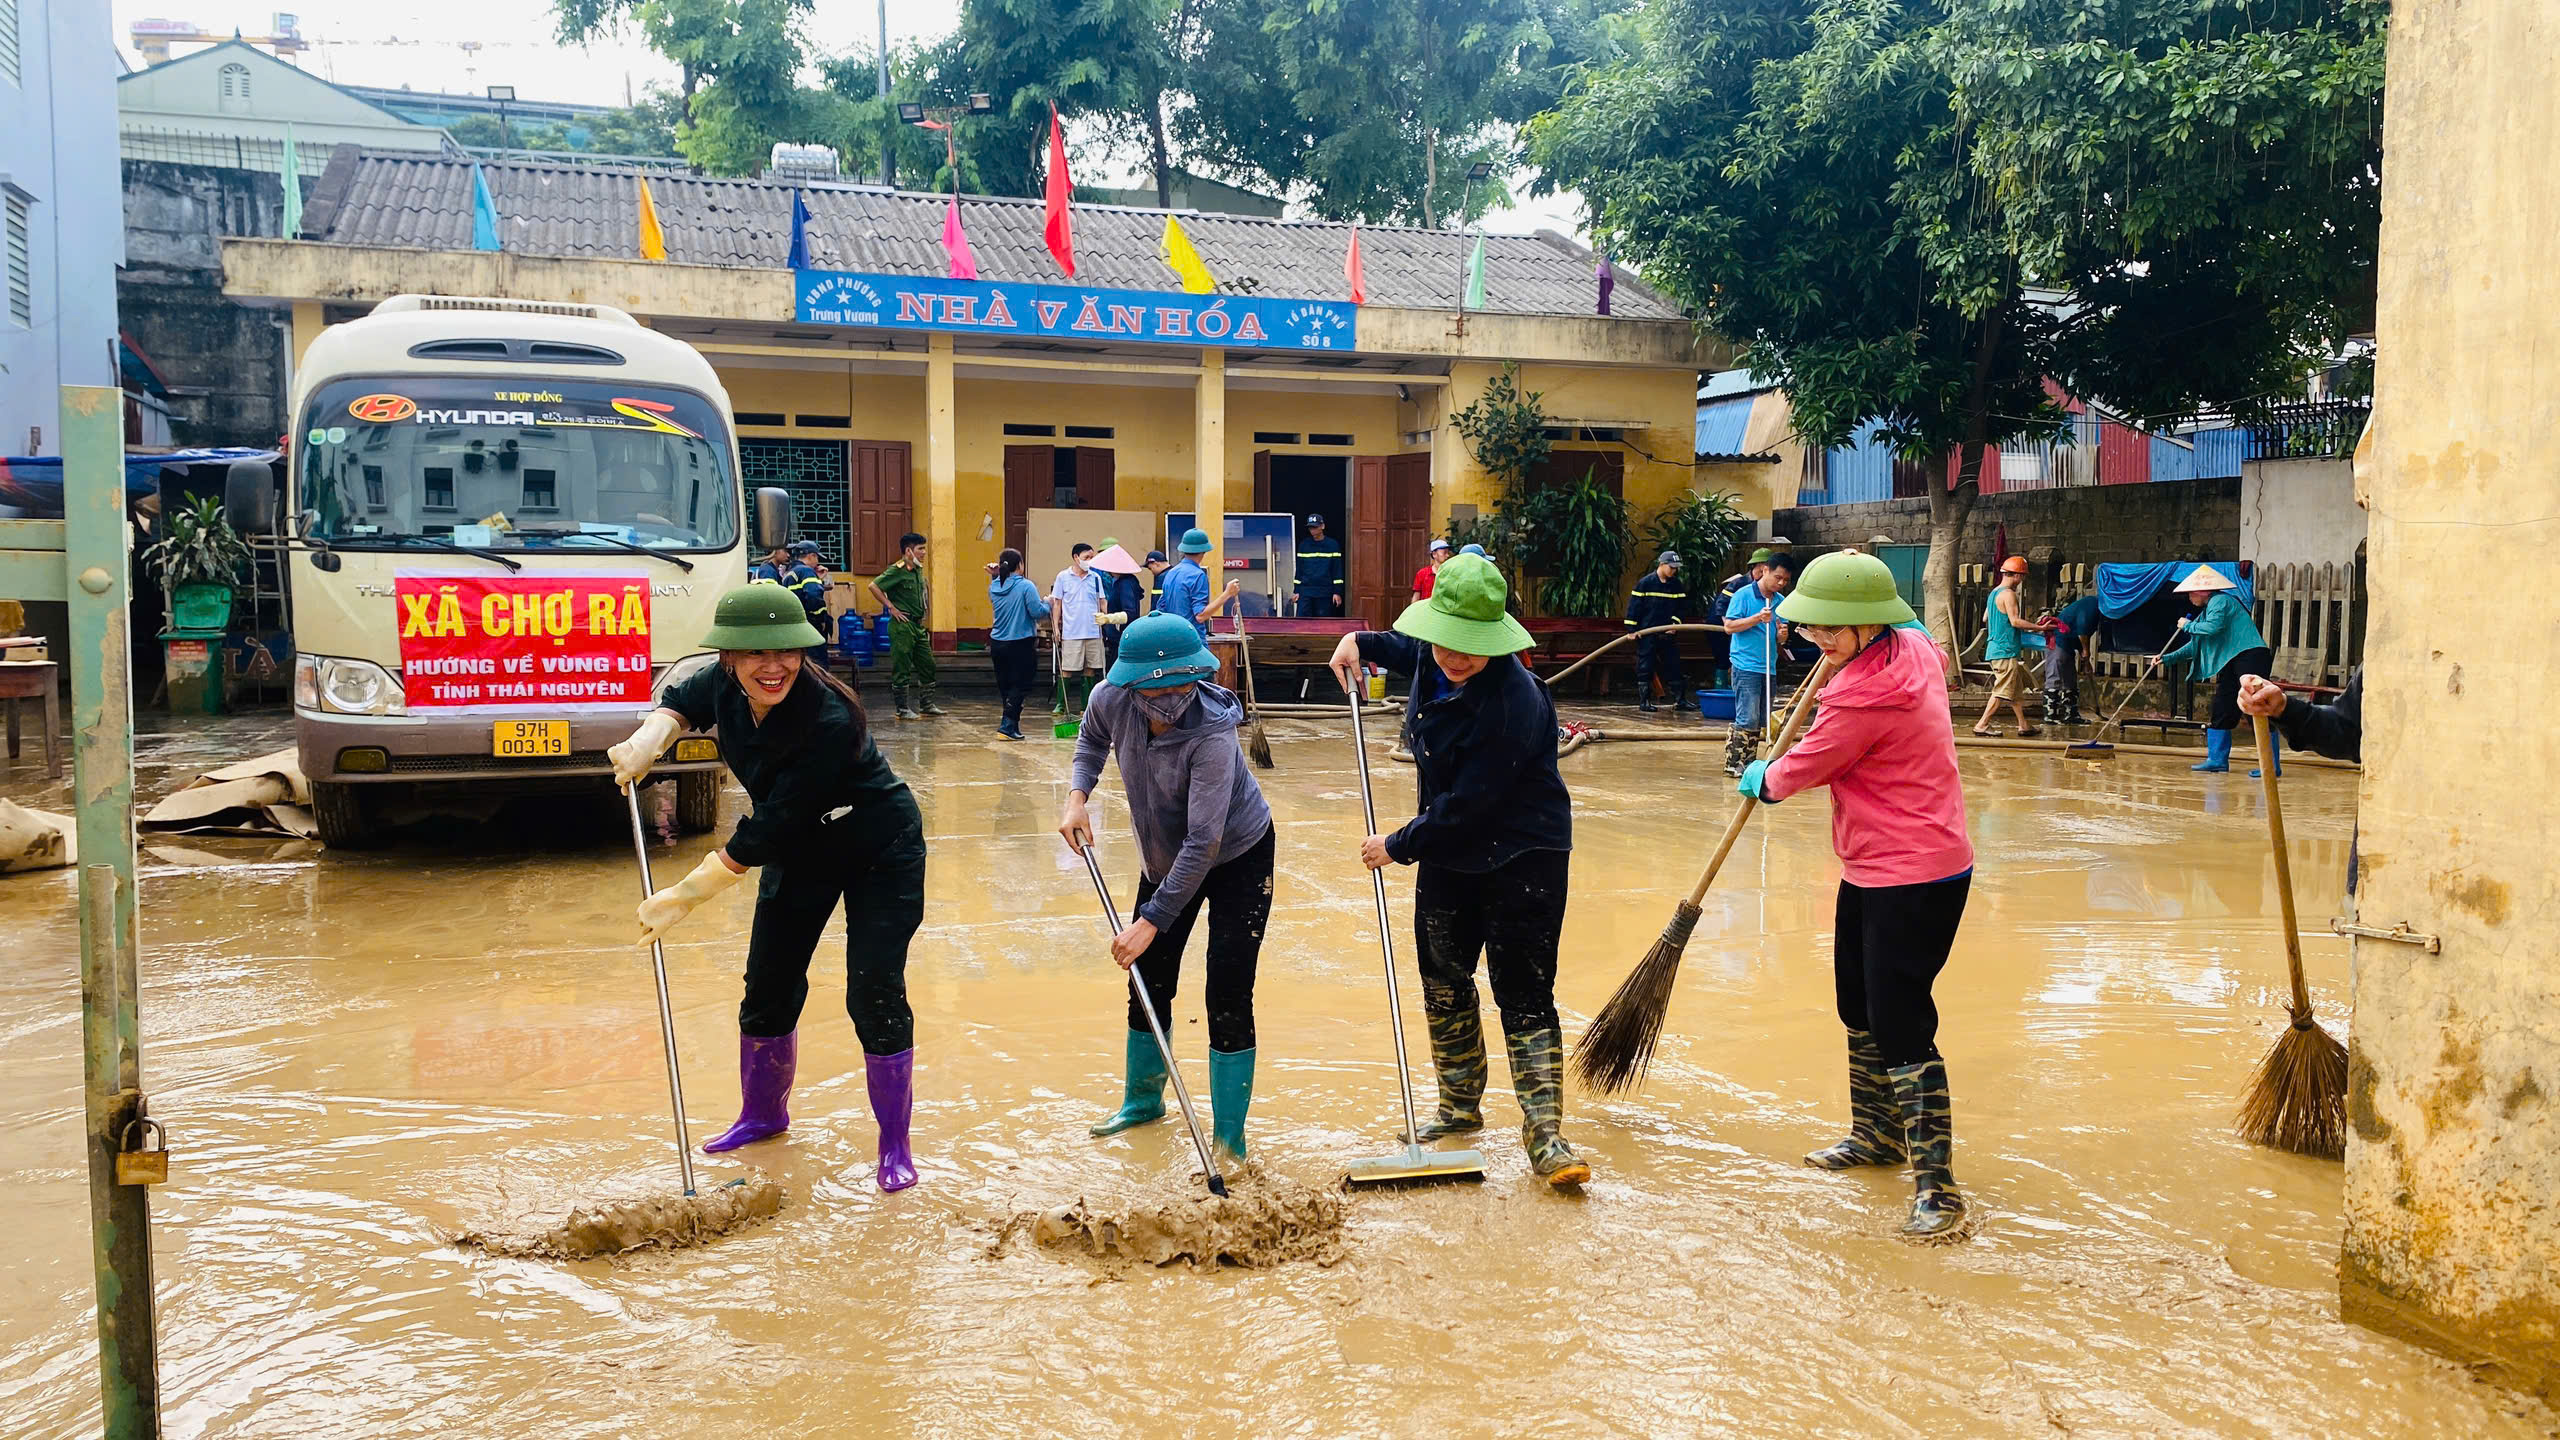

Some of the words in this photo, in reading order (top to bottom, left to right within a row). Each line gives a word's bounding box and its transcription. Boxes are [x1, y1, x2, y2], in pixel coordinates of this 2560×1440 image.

[805, 279, 834, 305] UBND
[809, 307, 841, 323] Trưng
[843, 308, 879, 325] Vương
[896, 289, 1017, 327] NHÀ
[1030, 295, 1146, 334] VĂN
[1155, 299, 1268, 340] HÓA
[1302, 331, 1320, 347] SỐ
[494, 391, 507, 401] XE
[509, 391, 532, 404] HỢP
[533, 389, 563, 403] ĐỒNG
[416, 409, 534, 426] HYUNDAI
[1223, 559, 1244, 567] AMITO
[355, 583, 396, 597] THA
[650, 584, 694, 597] NTY
[401, 585, 467, 638] XÃ
[481, 589, 573, 646] CHỢ
[588, 585, 648, 636] RÃ
[406, 654, 495, 676] HƯỚNG
[503, 653, 534, 674] VỀ
[541, 654, 610, 673] VÙNG
[617, 653, 647, 672] LŨ
[431, 681, 480, 699] TỈNH
[488, 681, 534, 697] THÁI
[541, 681, 625, 696] NGUYÊN
[515, 722, 548, 738] 97H
[502, 739, 562, 755] 003.19
